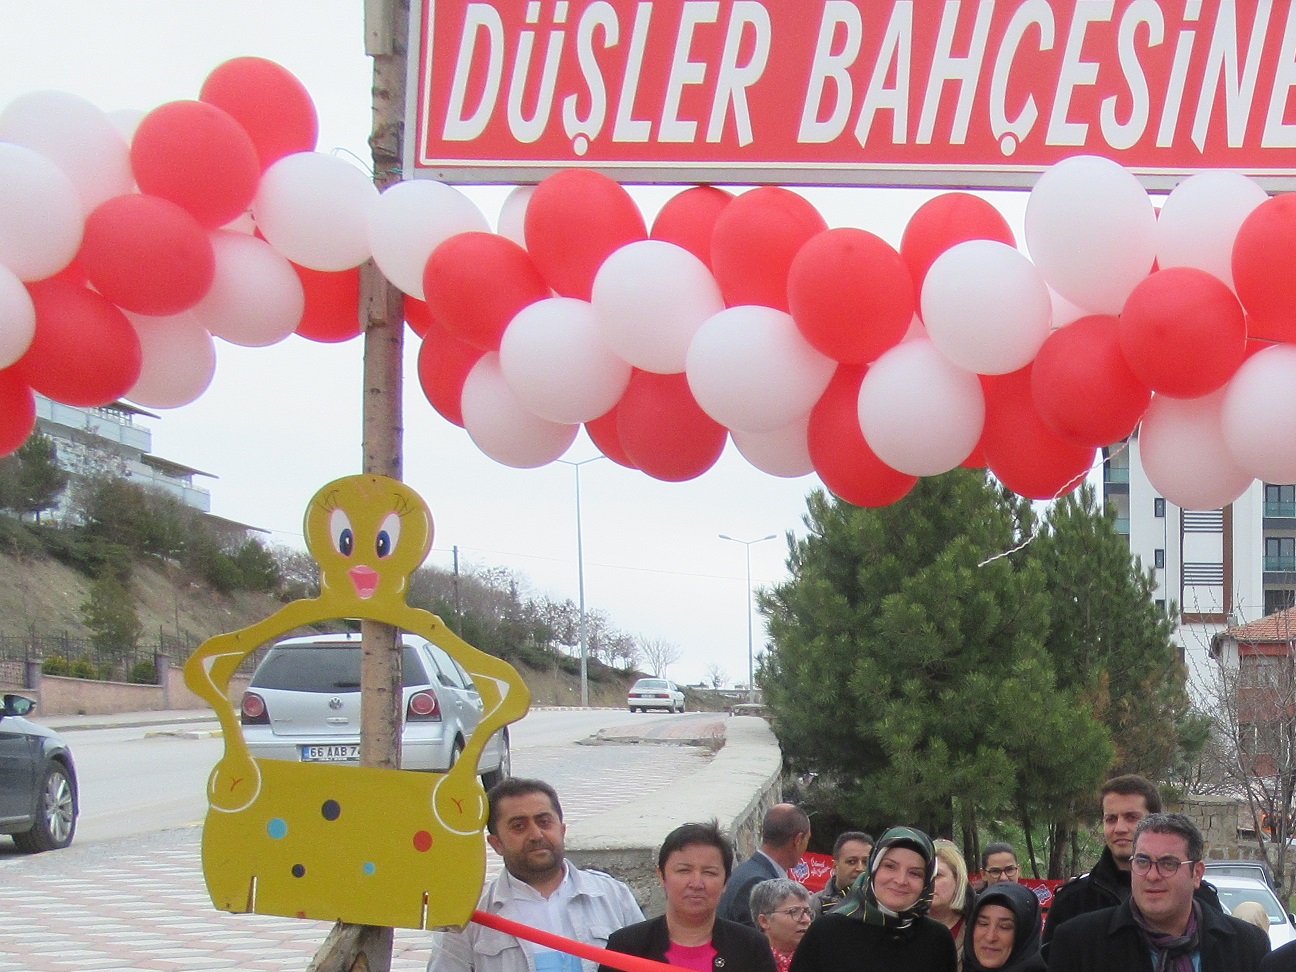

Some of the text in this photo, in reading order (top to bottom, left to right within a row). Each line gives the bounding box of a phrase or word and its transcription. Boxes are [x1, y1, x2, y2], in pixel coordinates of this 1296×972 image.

[442, 0, 771, 155] DÜŞLER
[310, 747, 324, 757] 66
[327, 746, 347, 757] AAB
